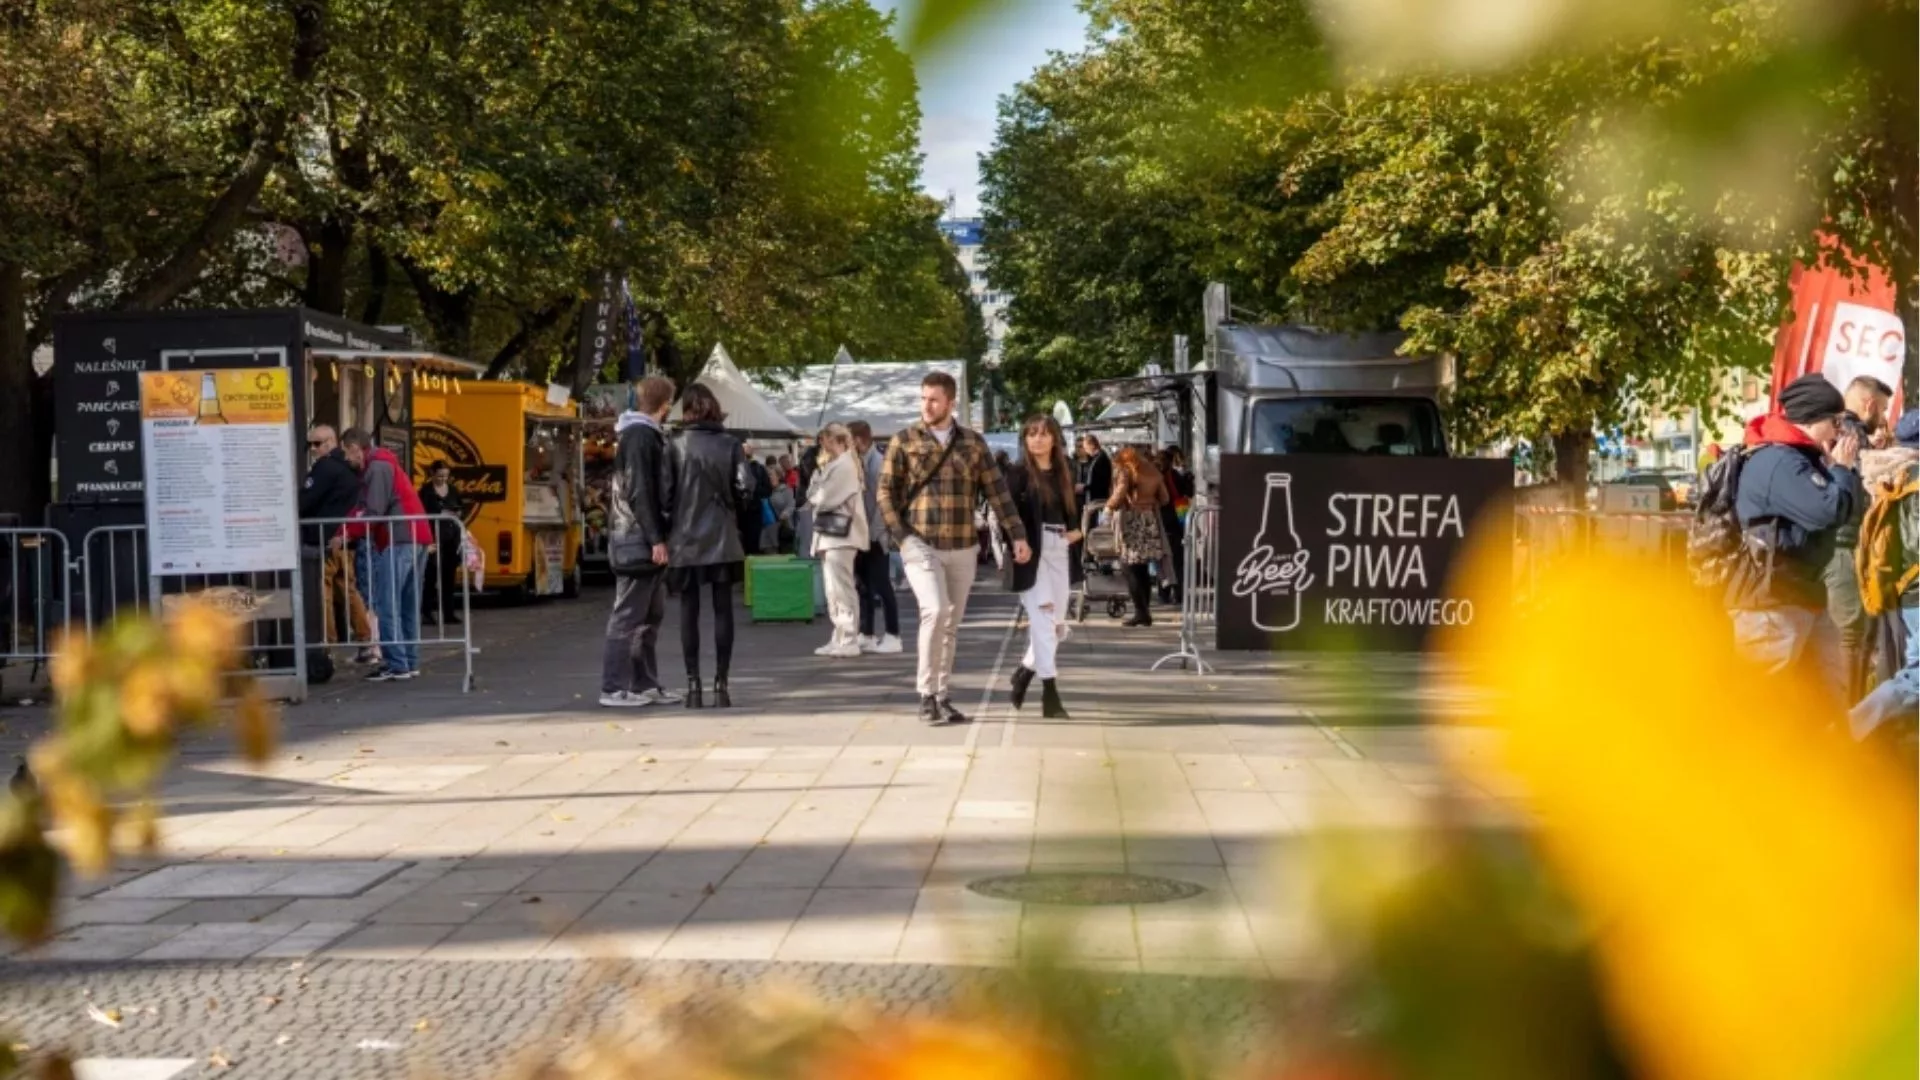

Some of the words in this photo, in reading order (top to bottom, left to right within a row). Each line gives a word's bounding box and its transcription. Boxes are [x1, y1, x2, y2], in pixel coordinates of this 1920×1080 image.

[1836, 320, 1903, 362] SEC
[74, 358, 147, 373] NALEŚNIKI
[222, 391, 285, 402] OKTOBERFEST
[88, 440, 135, 453] CREPES
[1326, 492, 1464, 538] STREFA
[1232, 545, 1315, 597] Beer
[1327, 544, 1427, 588] PIWA
[1324, 598, 1474, 625] KRAFTOWEGO
